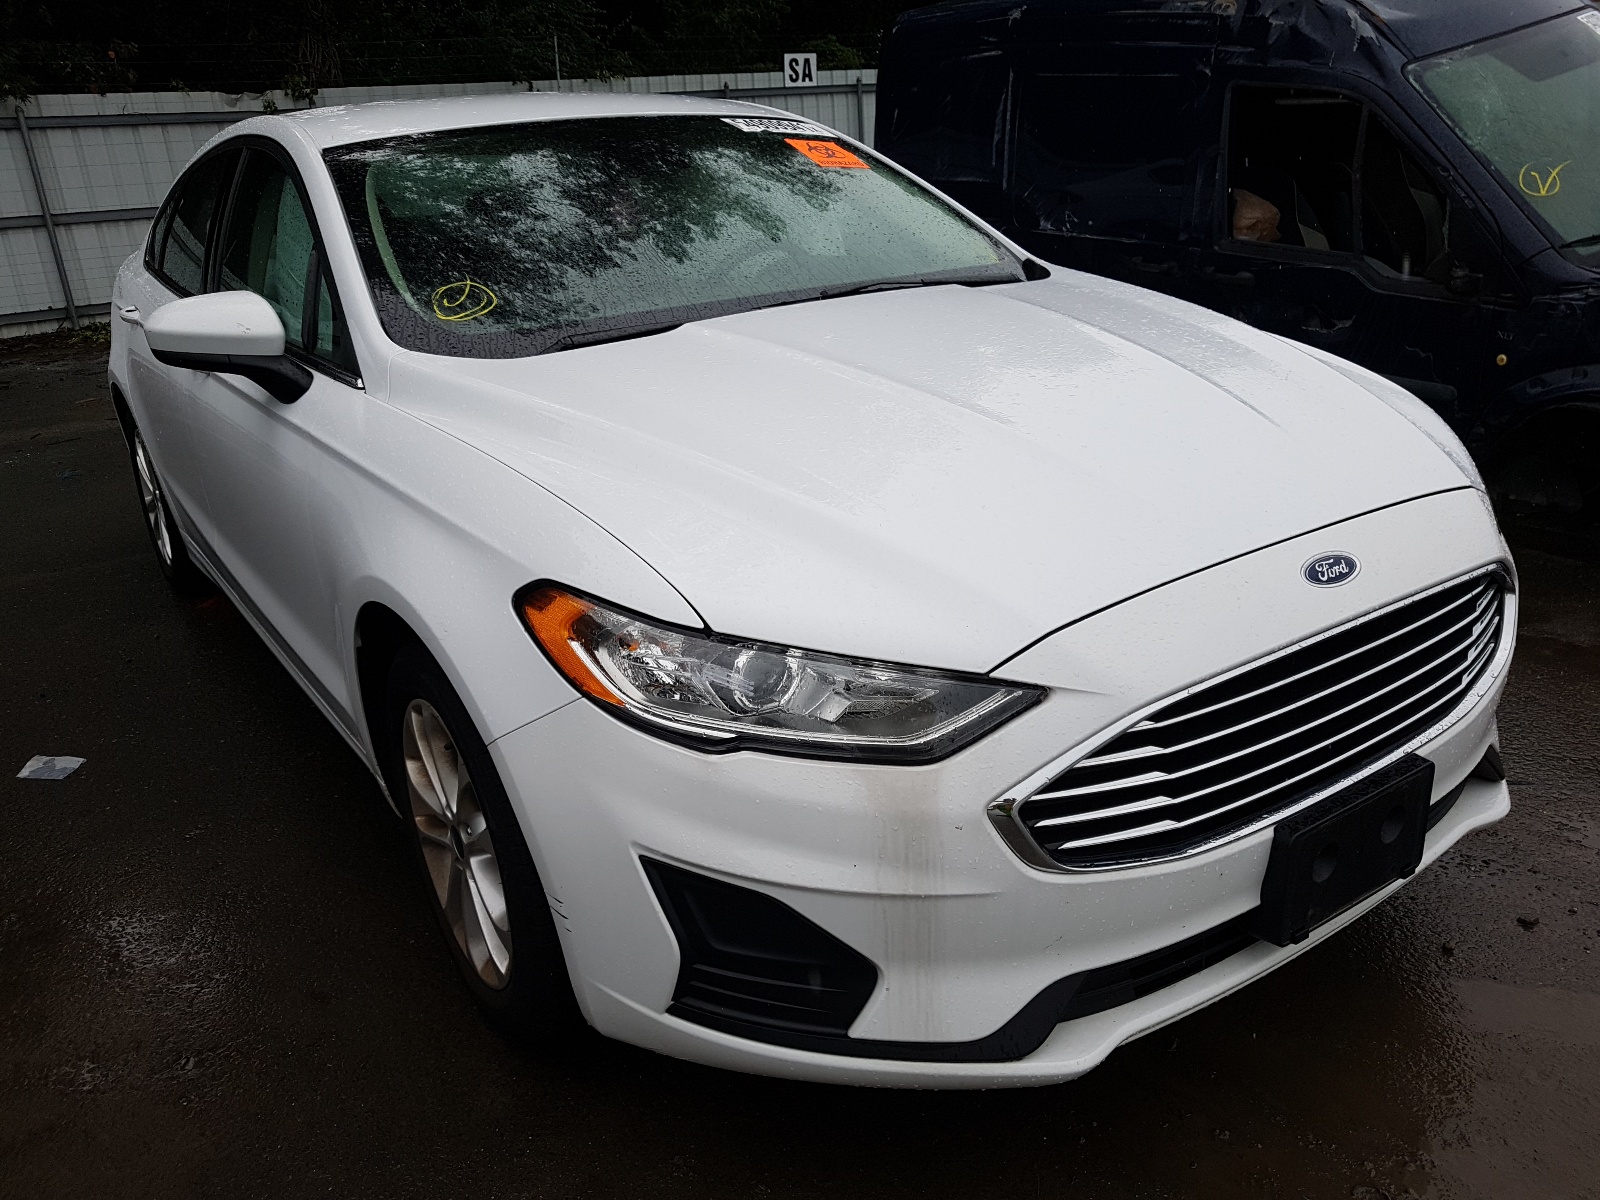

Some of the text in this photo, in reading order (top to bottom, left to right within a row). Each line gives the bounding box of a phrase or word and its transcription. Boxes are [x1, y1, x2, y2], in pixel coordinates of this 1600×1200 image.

[788, 57, 814, 83] SA
[1496, 330, 1516, 341] XLT
[1315, 558, 1349, 582] Ford
